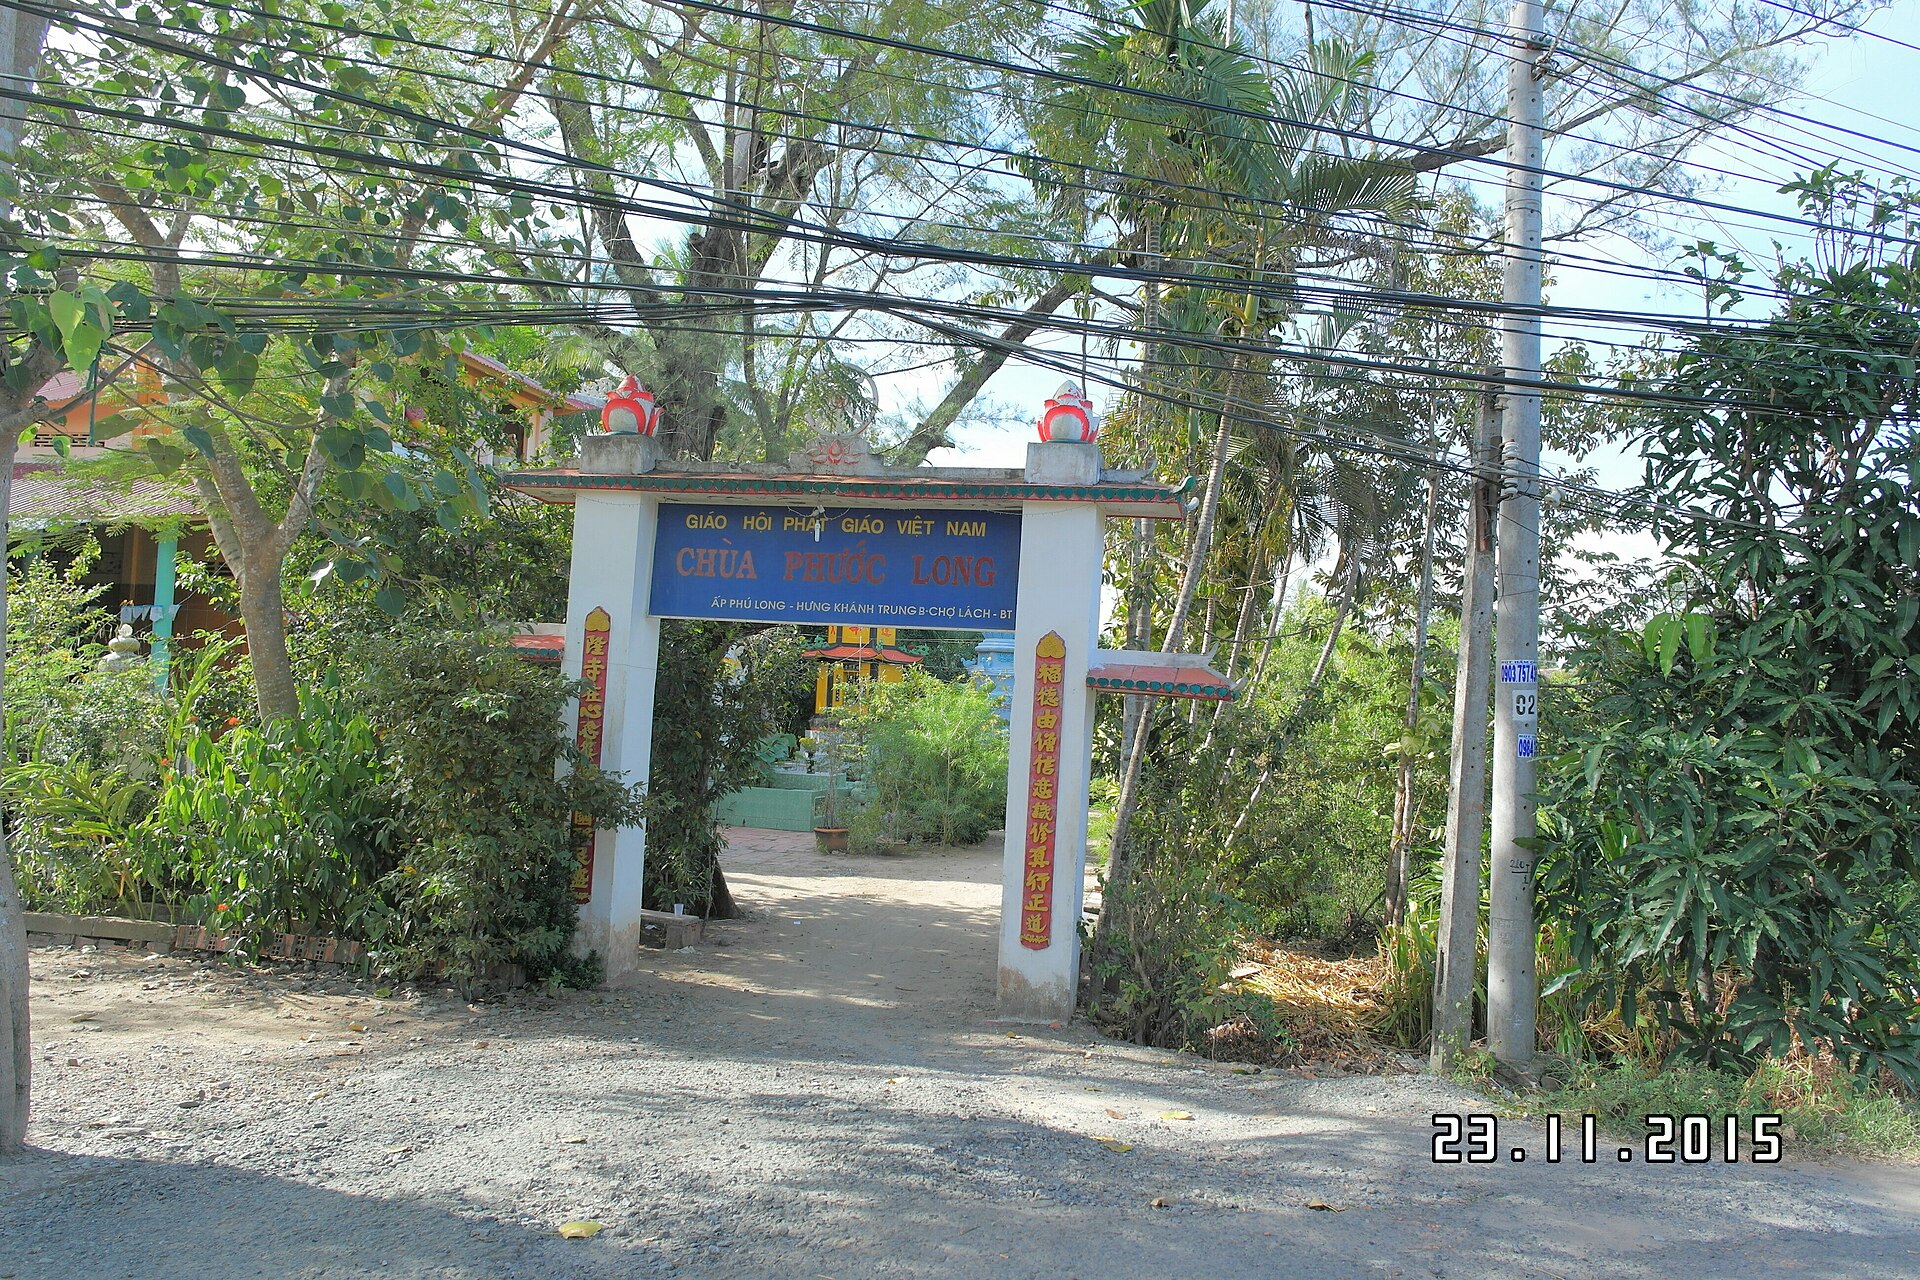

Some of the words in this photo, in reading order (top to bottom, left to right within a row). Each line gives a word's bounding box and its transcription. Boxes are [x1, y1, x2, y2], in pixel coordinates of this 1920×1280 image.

[685, 511, 728, 530] GIÁO
[743, 511, 772, 533] HỘI
[841, 514, 885, 534] GIÁO
[896, 515, 935, 537] VIỆT
[946, 520, 987, 537] NAM
[675, 538, 758, 580] CHÙA
[783, 540, 886, 585] PHƯỚC
[911, 554, 997, 587] LONG
[710, 595, 727, 608] ẤP
[729, 597, 752, 609] PHÚ
[754, 600, 786, 611] LONG
[796, 600, 831, 612] HƯNG
[834, 601, 874, 615] KHÁNH
[877, 604, 917, 616] TRUNG
[958, 605, 991, 619] LÁCH
[1000, 609, 1013, 619] BT
[1516, 694, 1535, 716] 02
